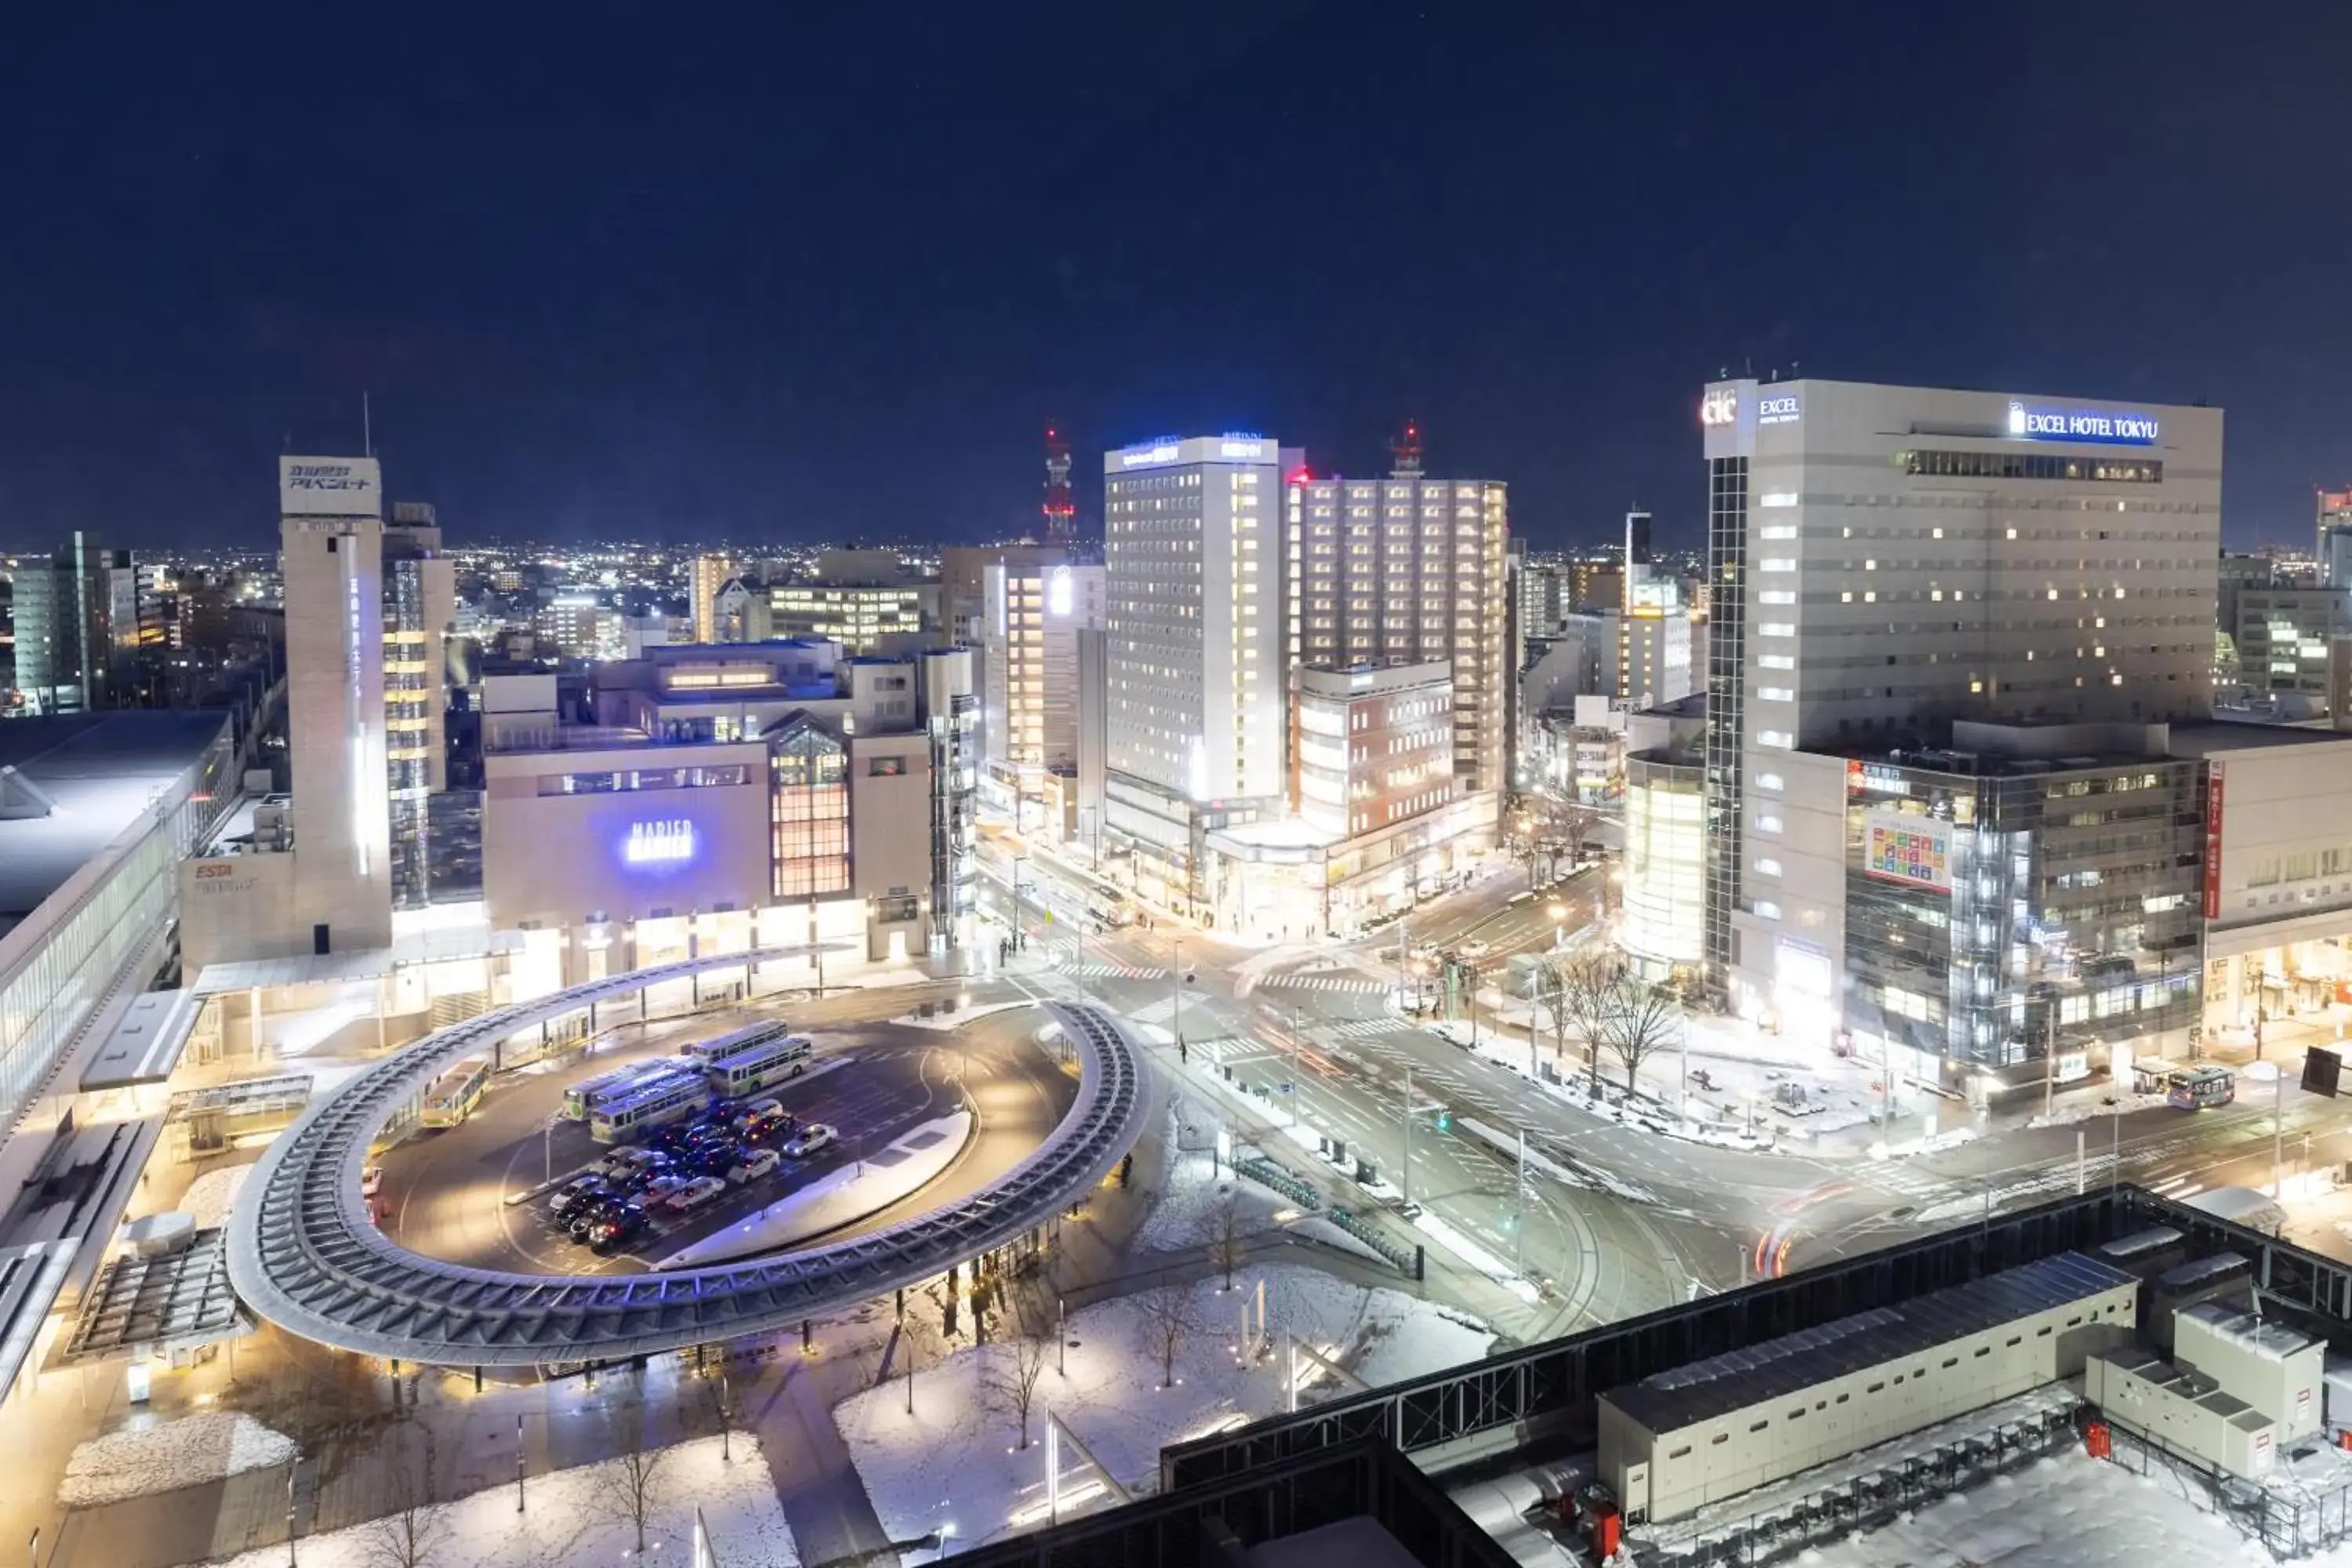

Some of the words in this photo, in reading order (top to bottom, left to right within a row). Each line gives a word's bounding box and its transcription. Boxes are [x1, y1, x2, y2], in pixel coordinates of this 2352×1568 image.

[1760, 397, 1798, 415] EXCEL
[2027, 413, 2068, 434] EXCEL
[2070, 416, 2113, 436] HOTEL
[2114, 419, 2158, 438] TOKYU
